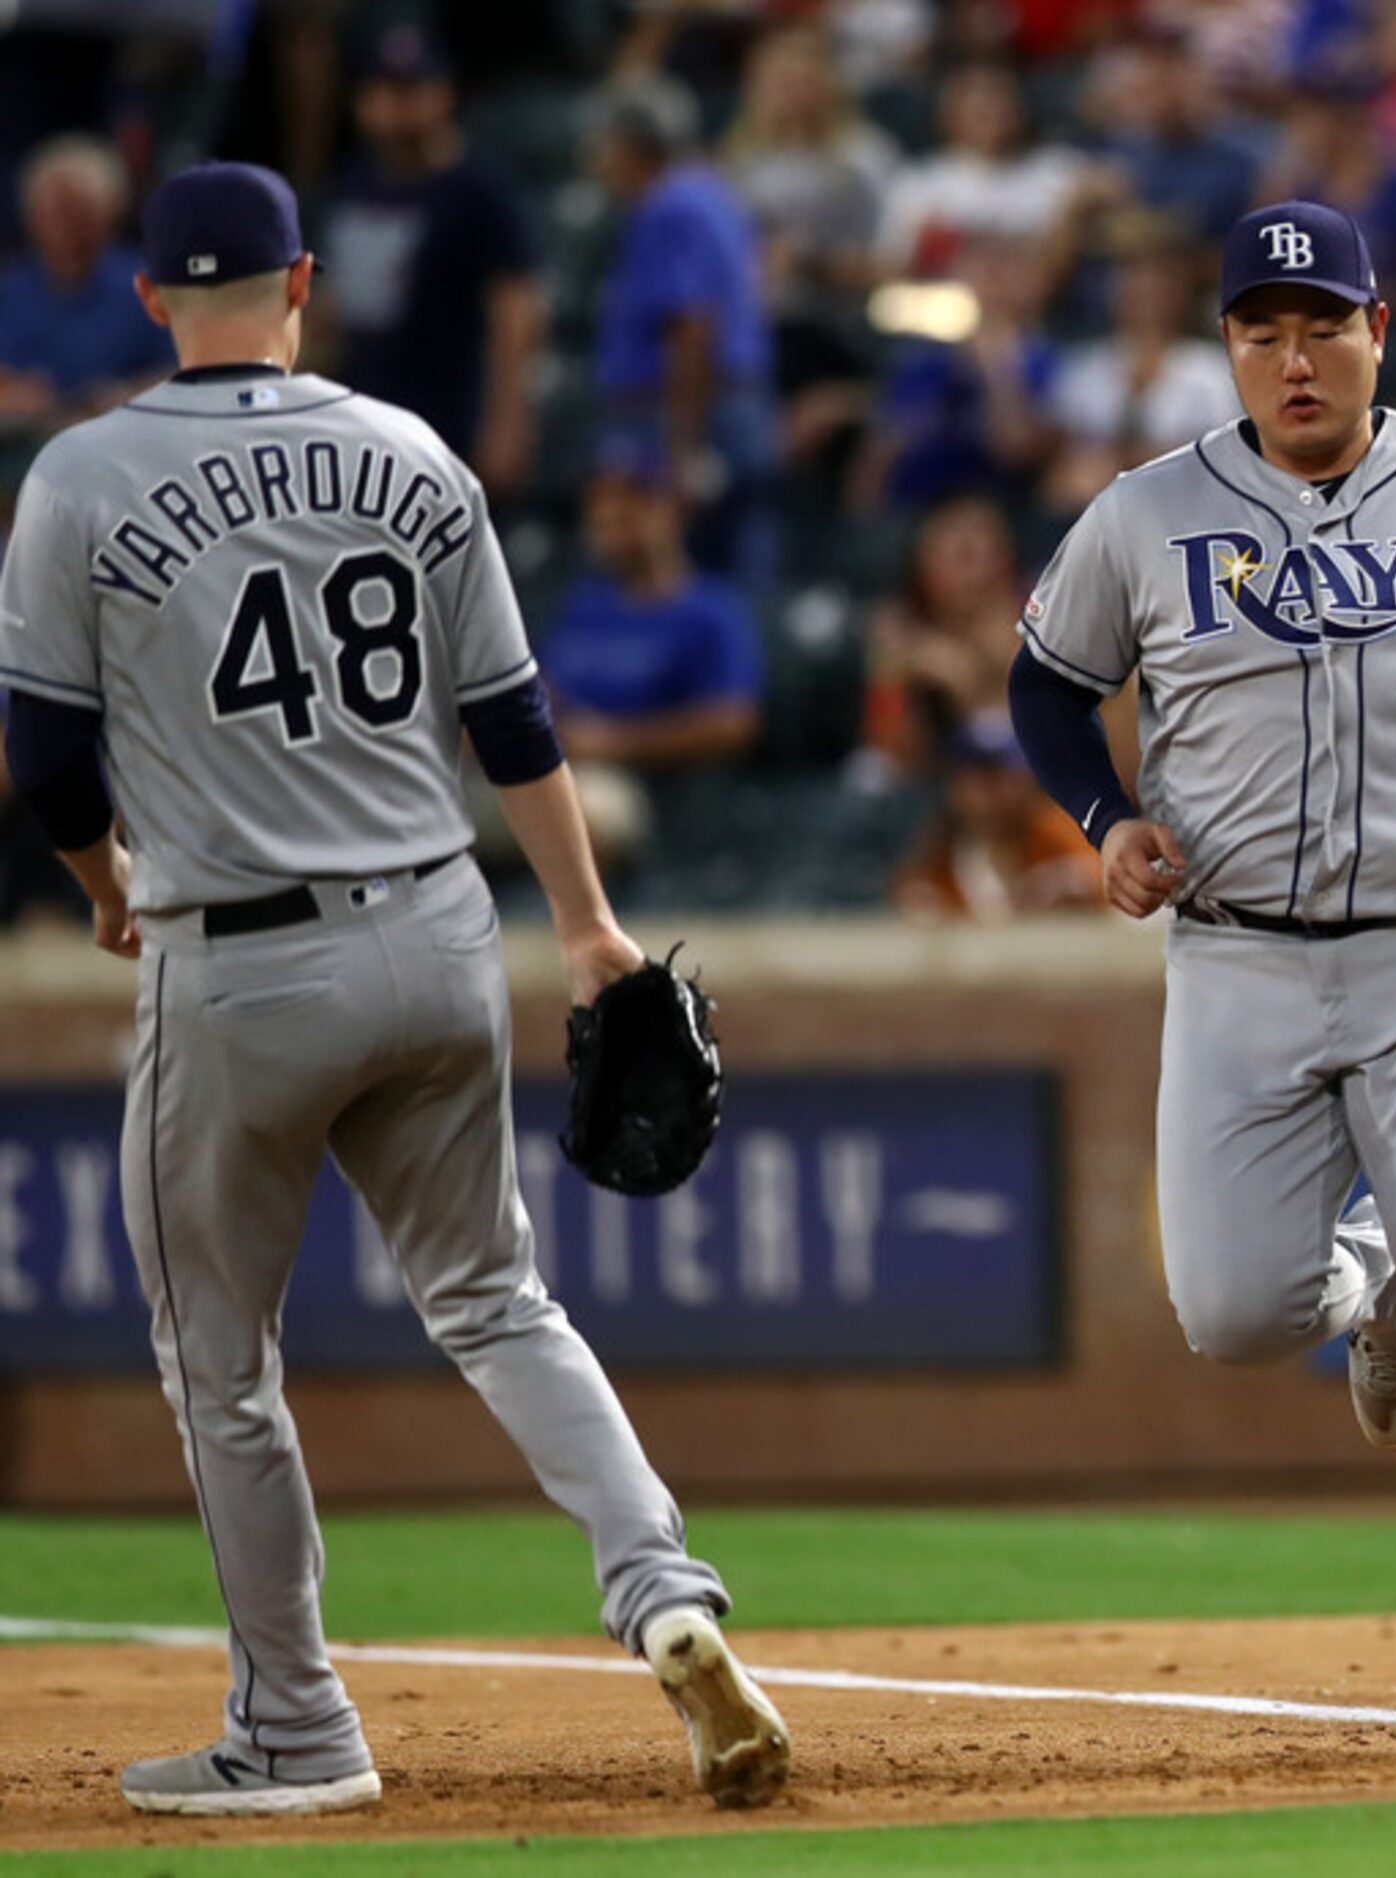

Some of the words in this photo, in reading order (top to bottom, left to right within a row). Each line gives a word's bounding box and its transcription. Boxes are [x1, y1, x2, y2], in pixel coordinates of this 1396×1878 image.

[1258, 222, 1315, 270] TB
[90, 441, 472, 606] YARBROUGH
[208, 545, 422, 747] 48
